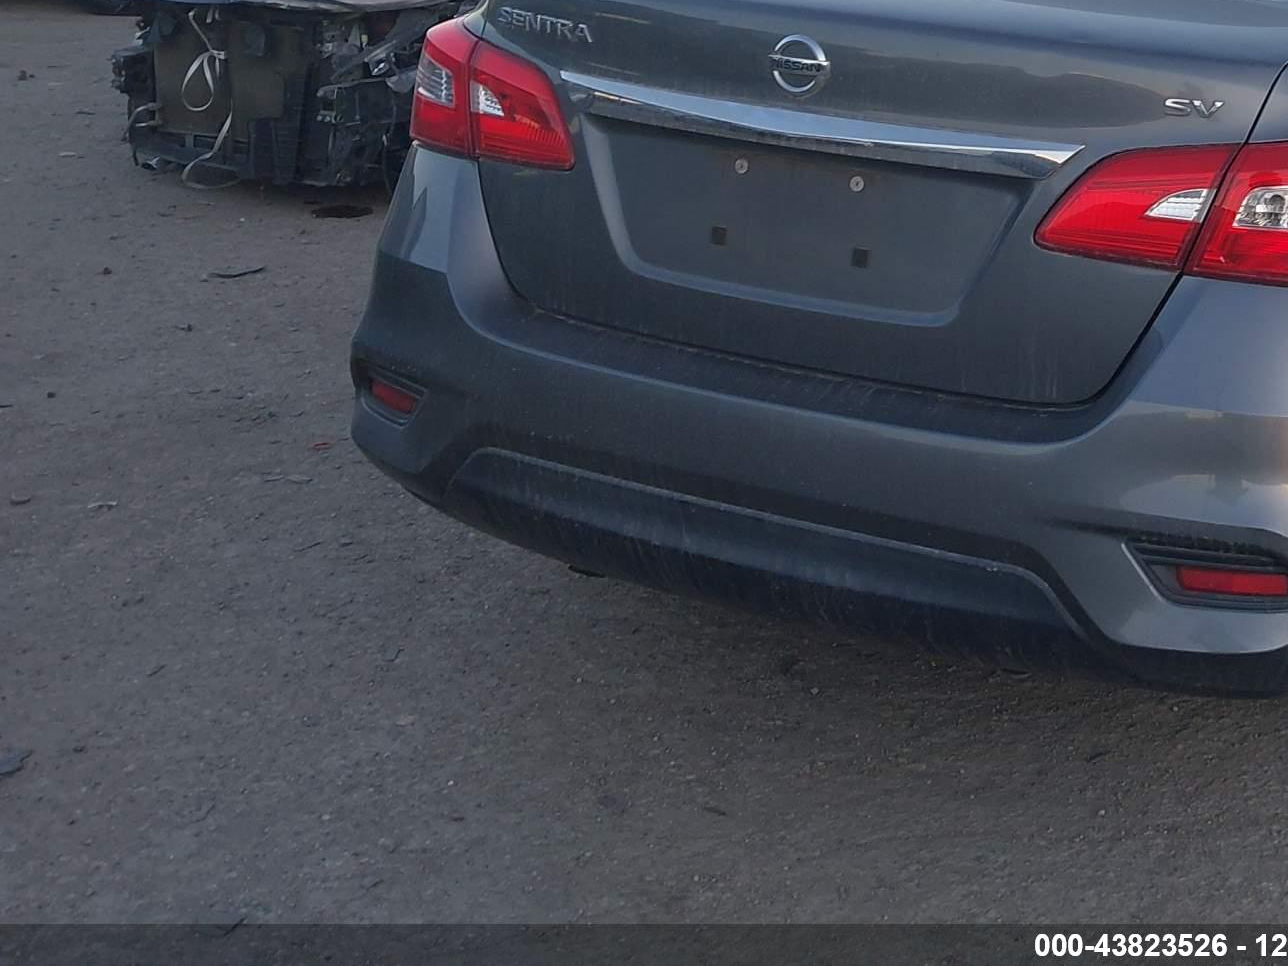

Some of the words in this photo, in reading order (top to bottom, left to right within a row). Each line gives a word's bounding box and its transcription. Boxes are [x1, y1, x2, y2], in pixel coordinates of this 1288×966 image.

[498, 7, 592, 43] SENTRA
[771, 57, 821, 72] NISSAN
[1164, 98, 1224, 118] SV
